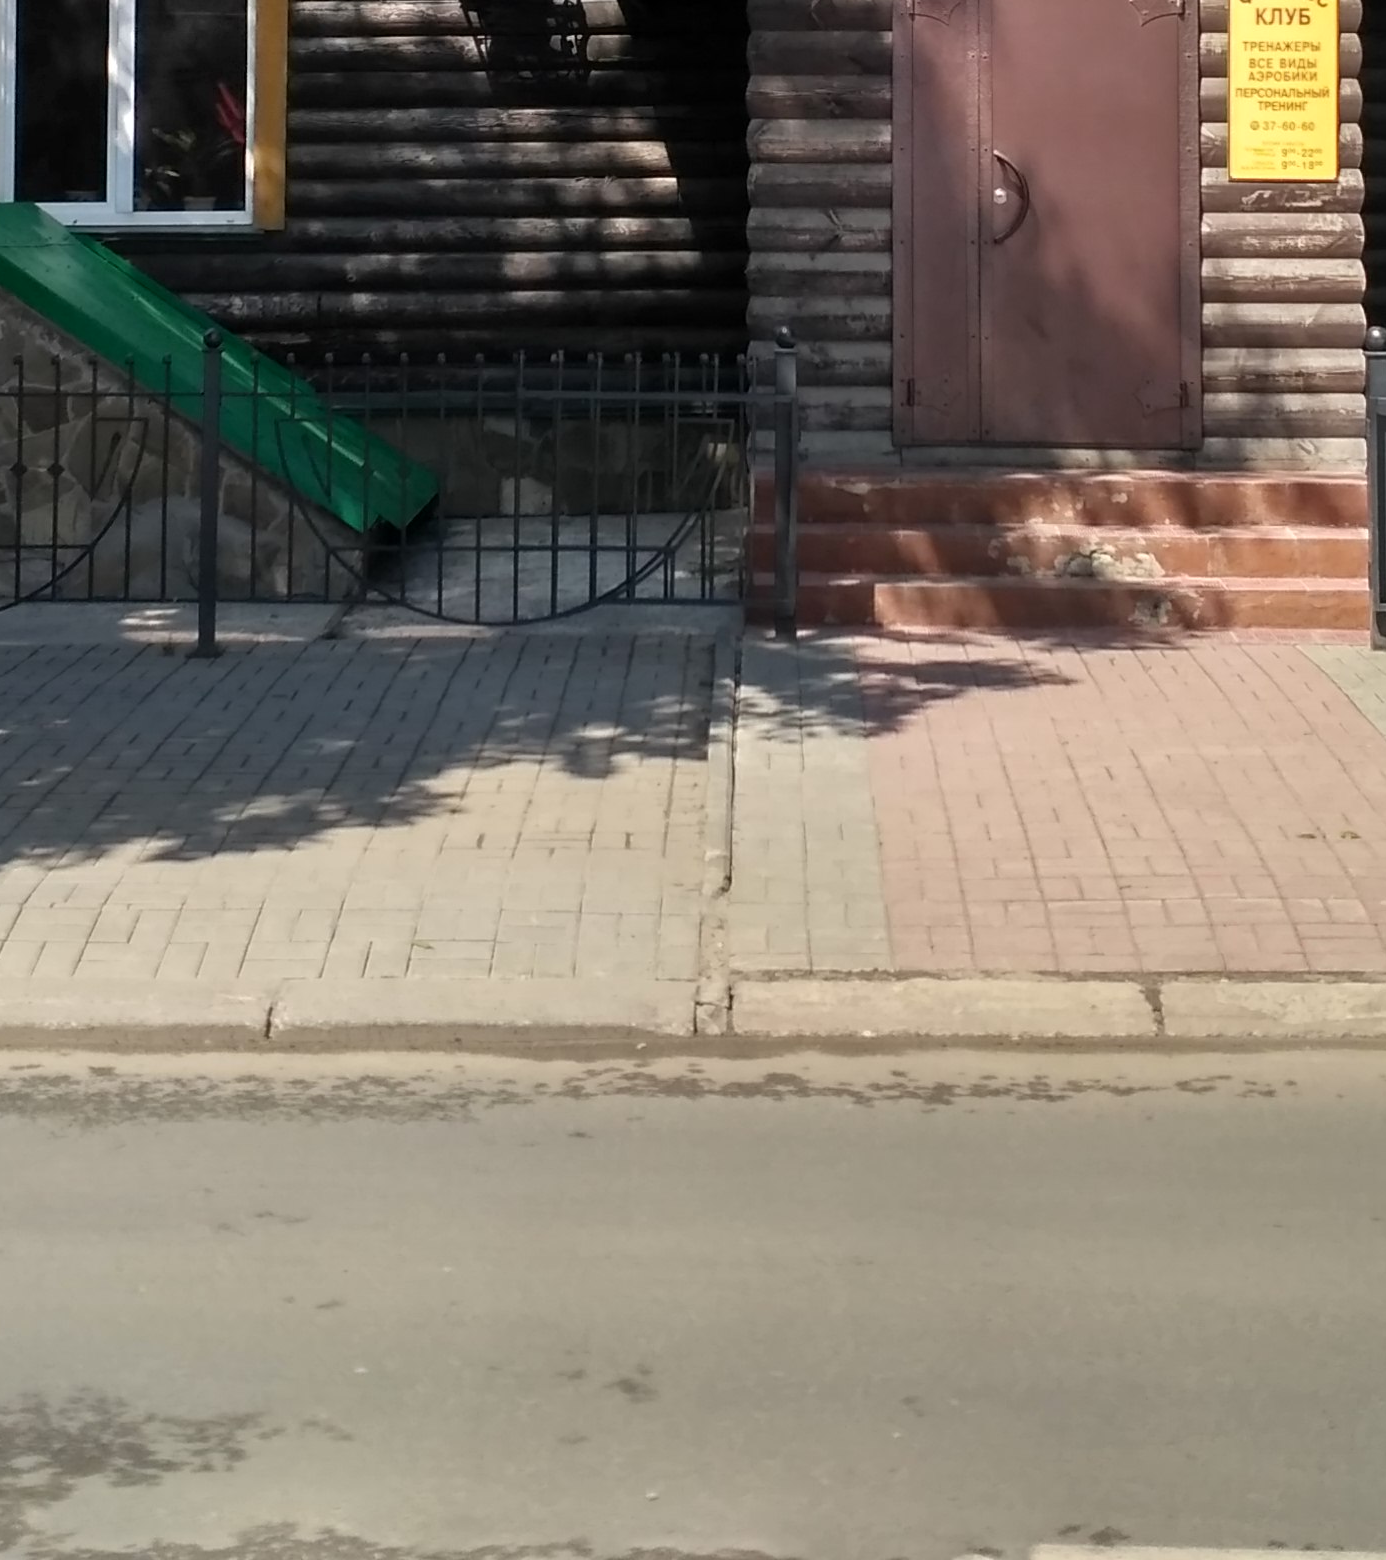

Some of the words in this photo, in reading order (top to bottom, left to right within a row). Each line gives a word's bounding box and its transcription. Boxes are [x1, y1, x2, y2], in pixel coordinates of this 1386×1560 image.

[1255, 7, 1312, 26] КЛУБ
[1243, 41, 1322, 53] ТРЕНАЖЕРЫ
[1248, 58, 1274, 70] ВСЕ
[1279, 58, 1318, 70] ВИДЫ
[1248, 71, 1319, 82] АЭРОБИКИ
[1235, 85, 1331, 99] ПЕРСОНАЛЬНЫЙ
[1257, 101, 1309, 112] ТРЕНИНГ
